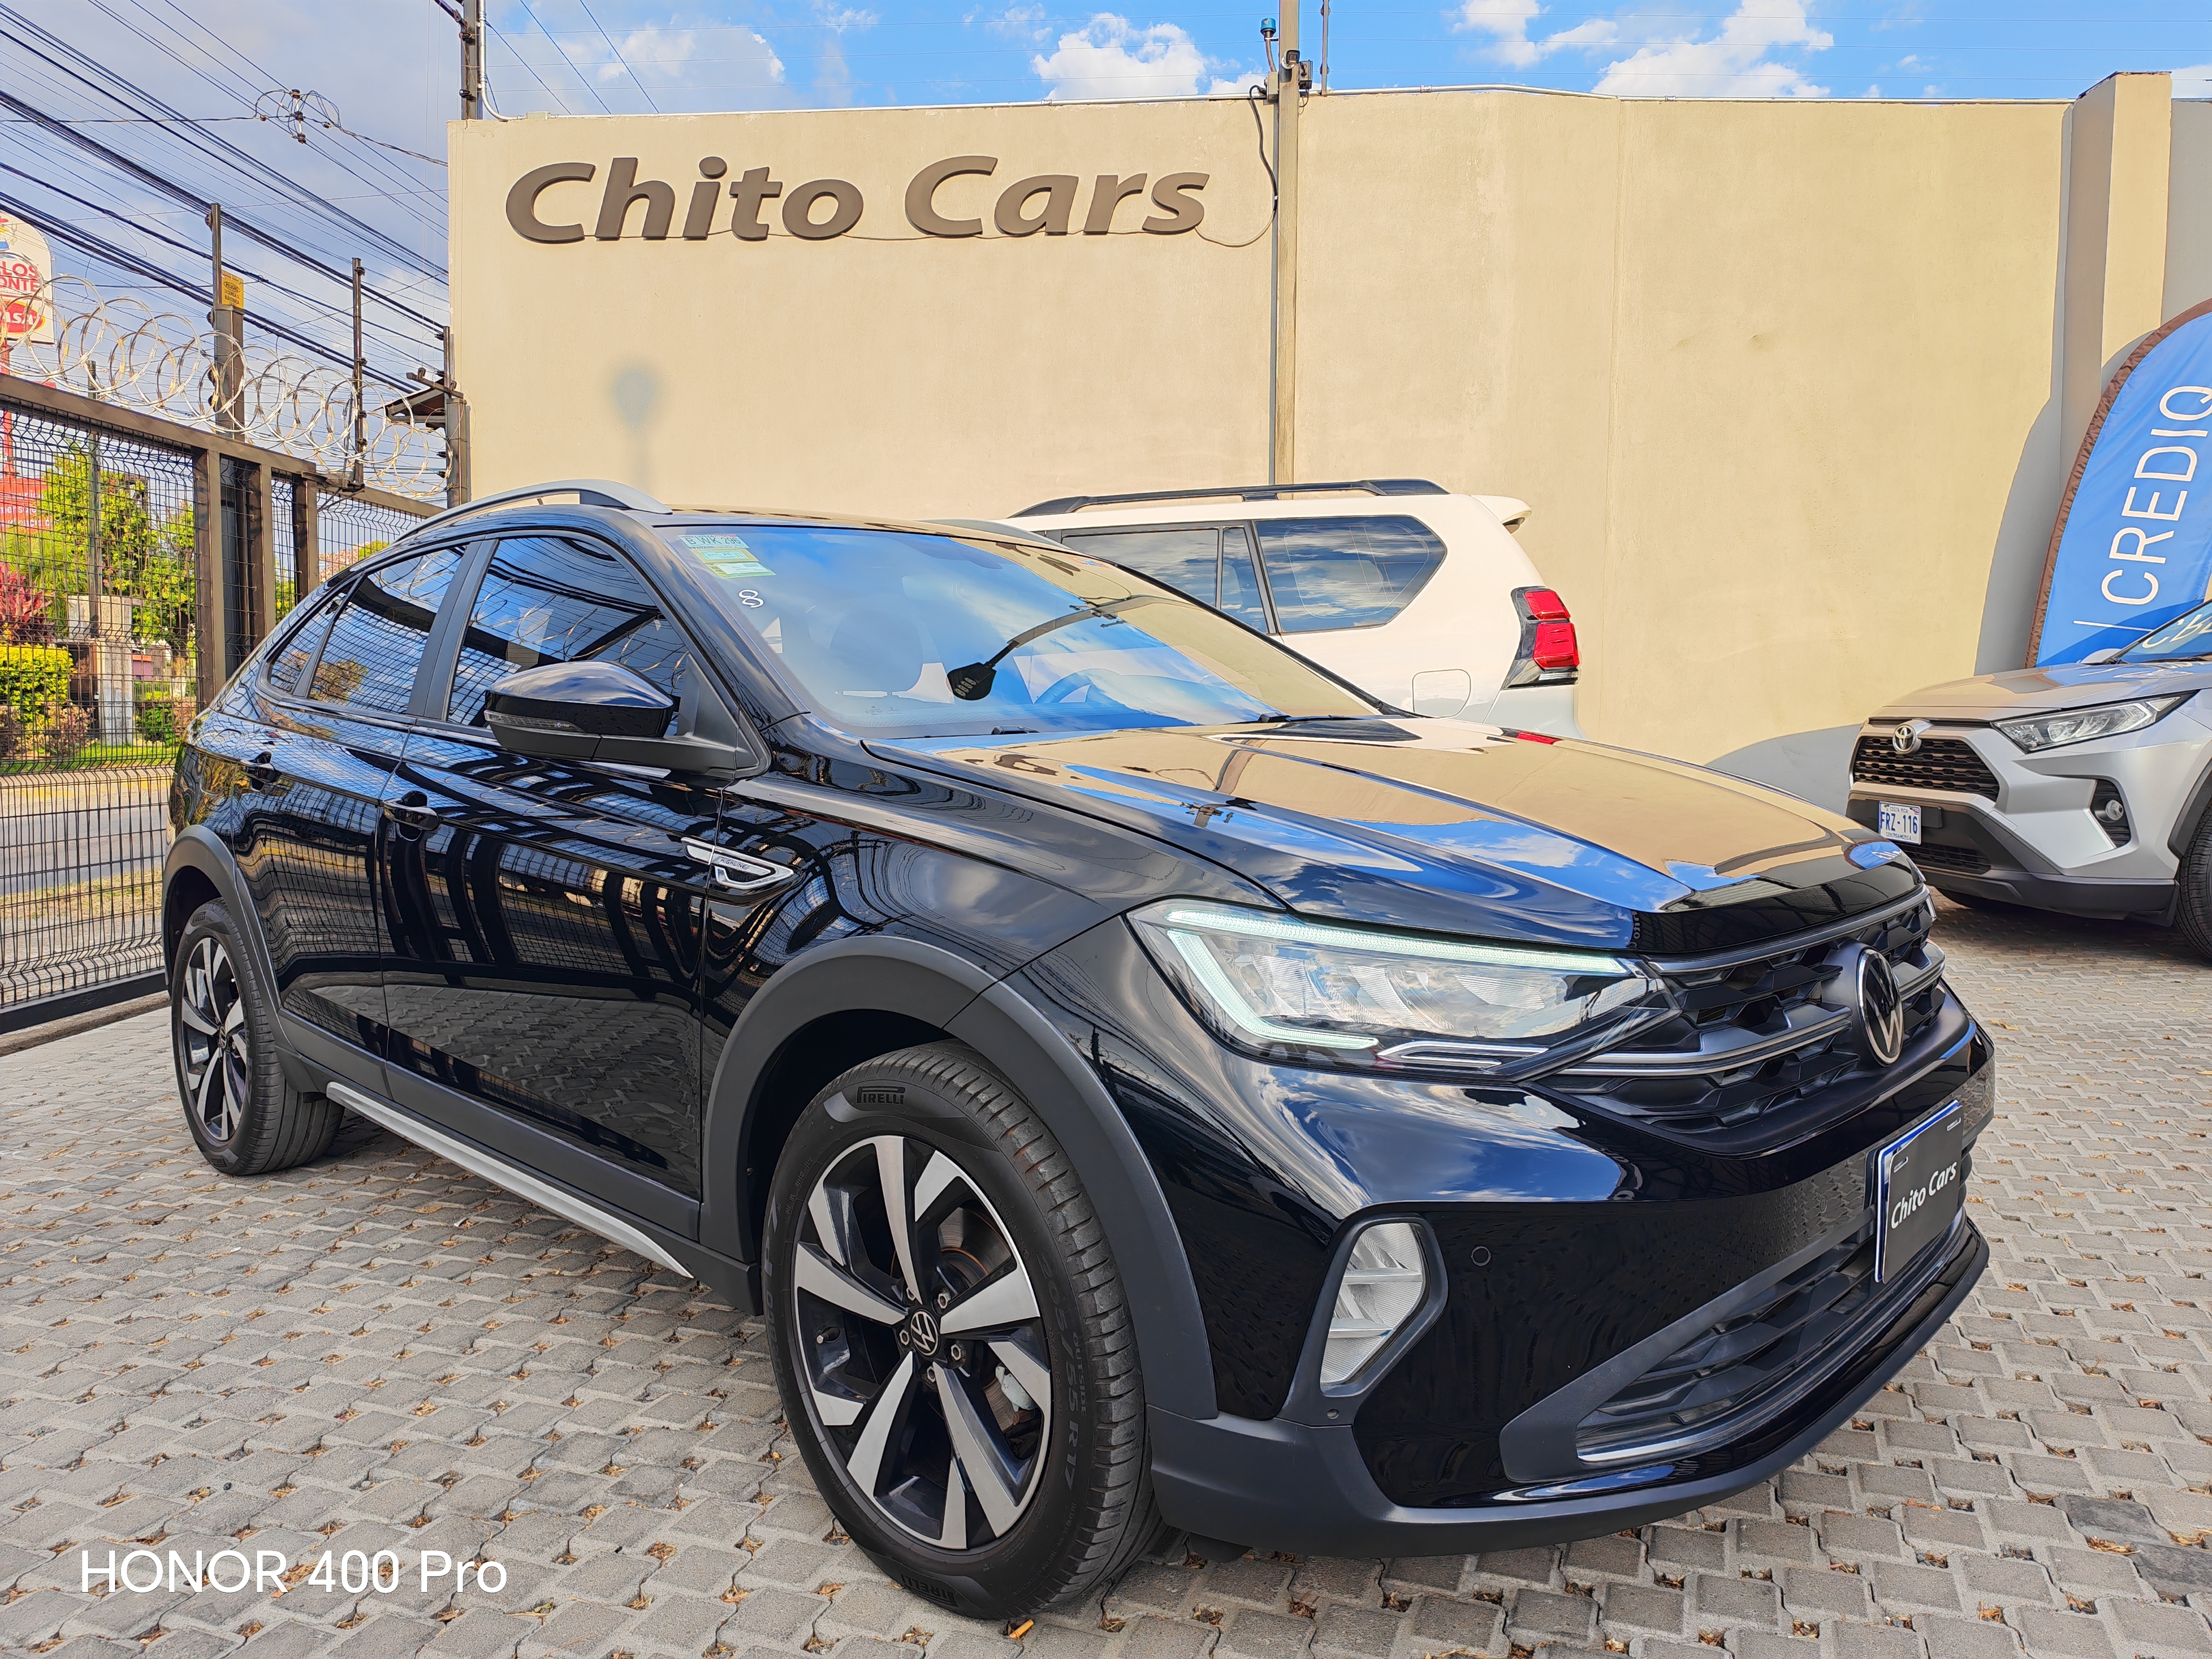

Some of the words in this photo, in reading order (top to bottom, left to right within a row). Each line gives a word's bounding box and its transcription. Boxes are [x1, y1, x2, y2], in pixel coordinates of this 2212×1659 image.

[505, 156, 864, 242] Chito
[905, 155, 1210, 238] Cars
[0, 261, 38, 279] LOS
[2101, 385, 2212, 605] CREDIQ
[720, 858, 747, 868] HIGHLINE
[857, 1085, 906, 1105] PIRELLI
[1891, 1186, 1927, 1230] Chito
[1928, 1161, 1958, 1197] Cars
[1072, 1331, 1087, 1417] OUTSIDE
